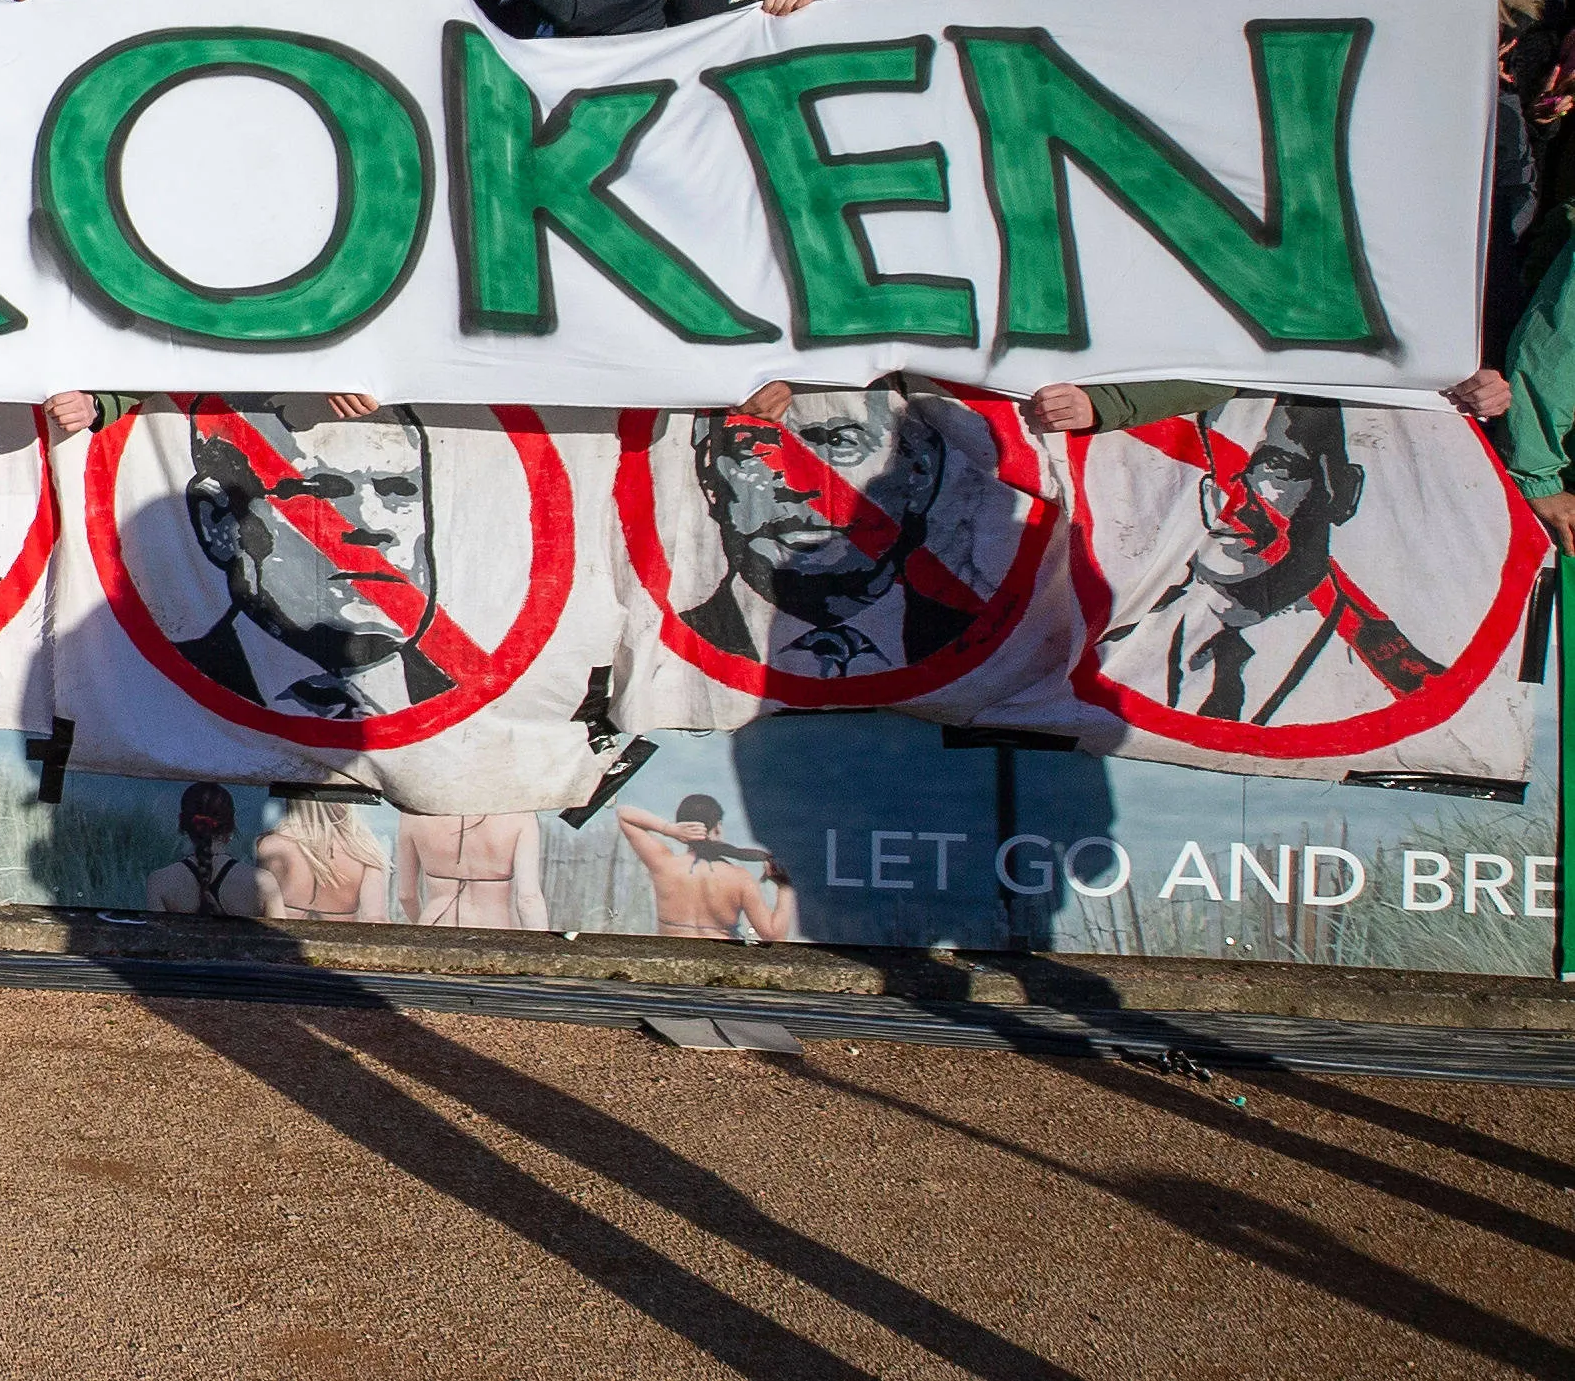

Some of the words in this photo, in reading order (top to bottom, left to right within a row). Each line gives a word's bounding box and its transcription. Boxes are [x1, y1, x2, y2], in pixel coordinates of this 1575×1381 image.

[826, 828, 967, 891] LET
[994, 834, 1131, 899] GO
[1157, 840, 1365, 907] AND
[1402, 850, 1557, 918] BRE
